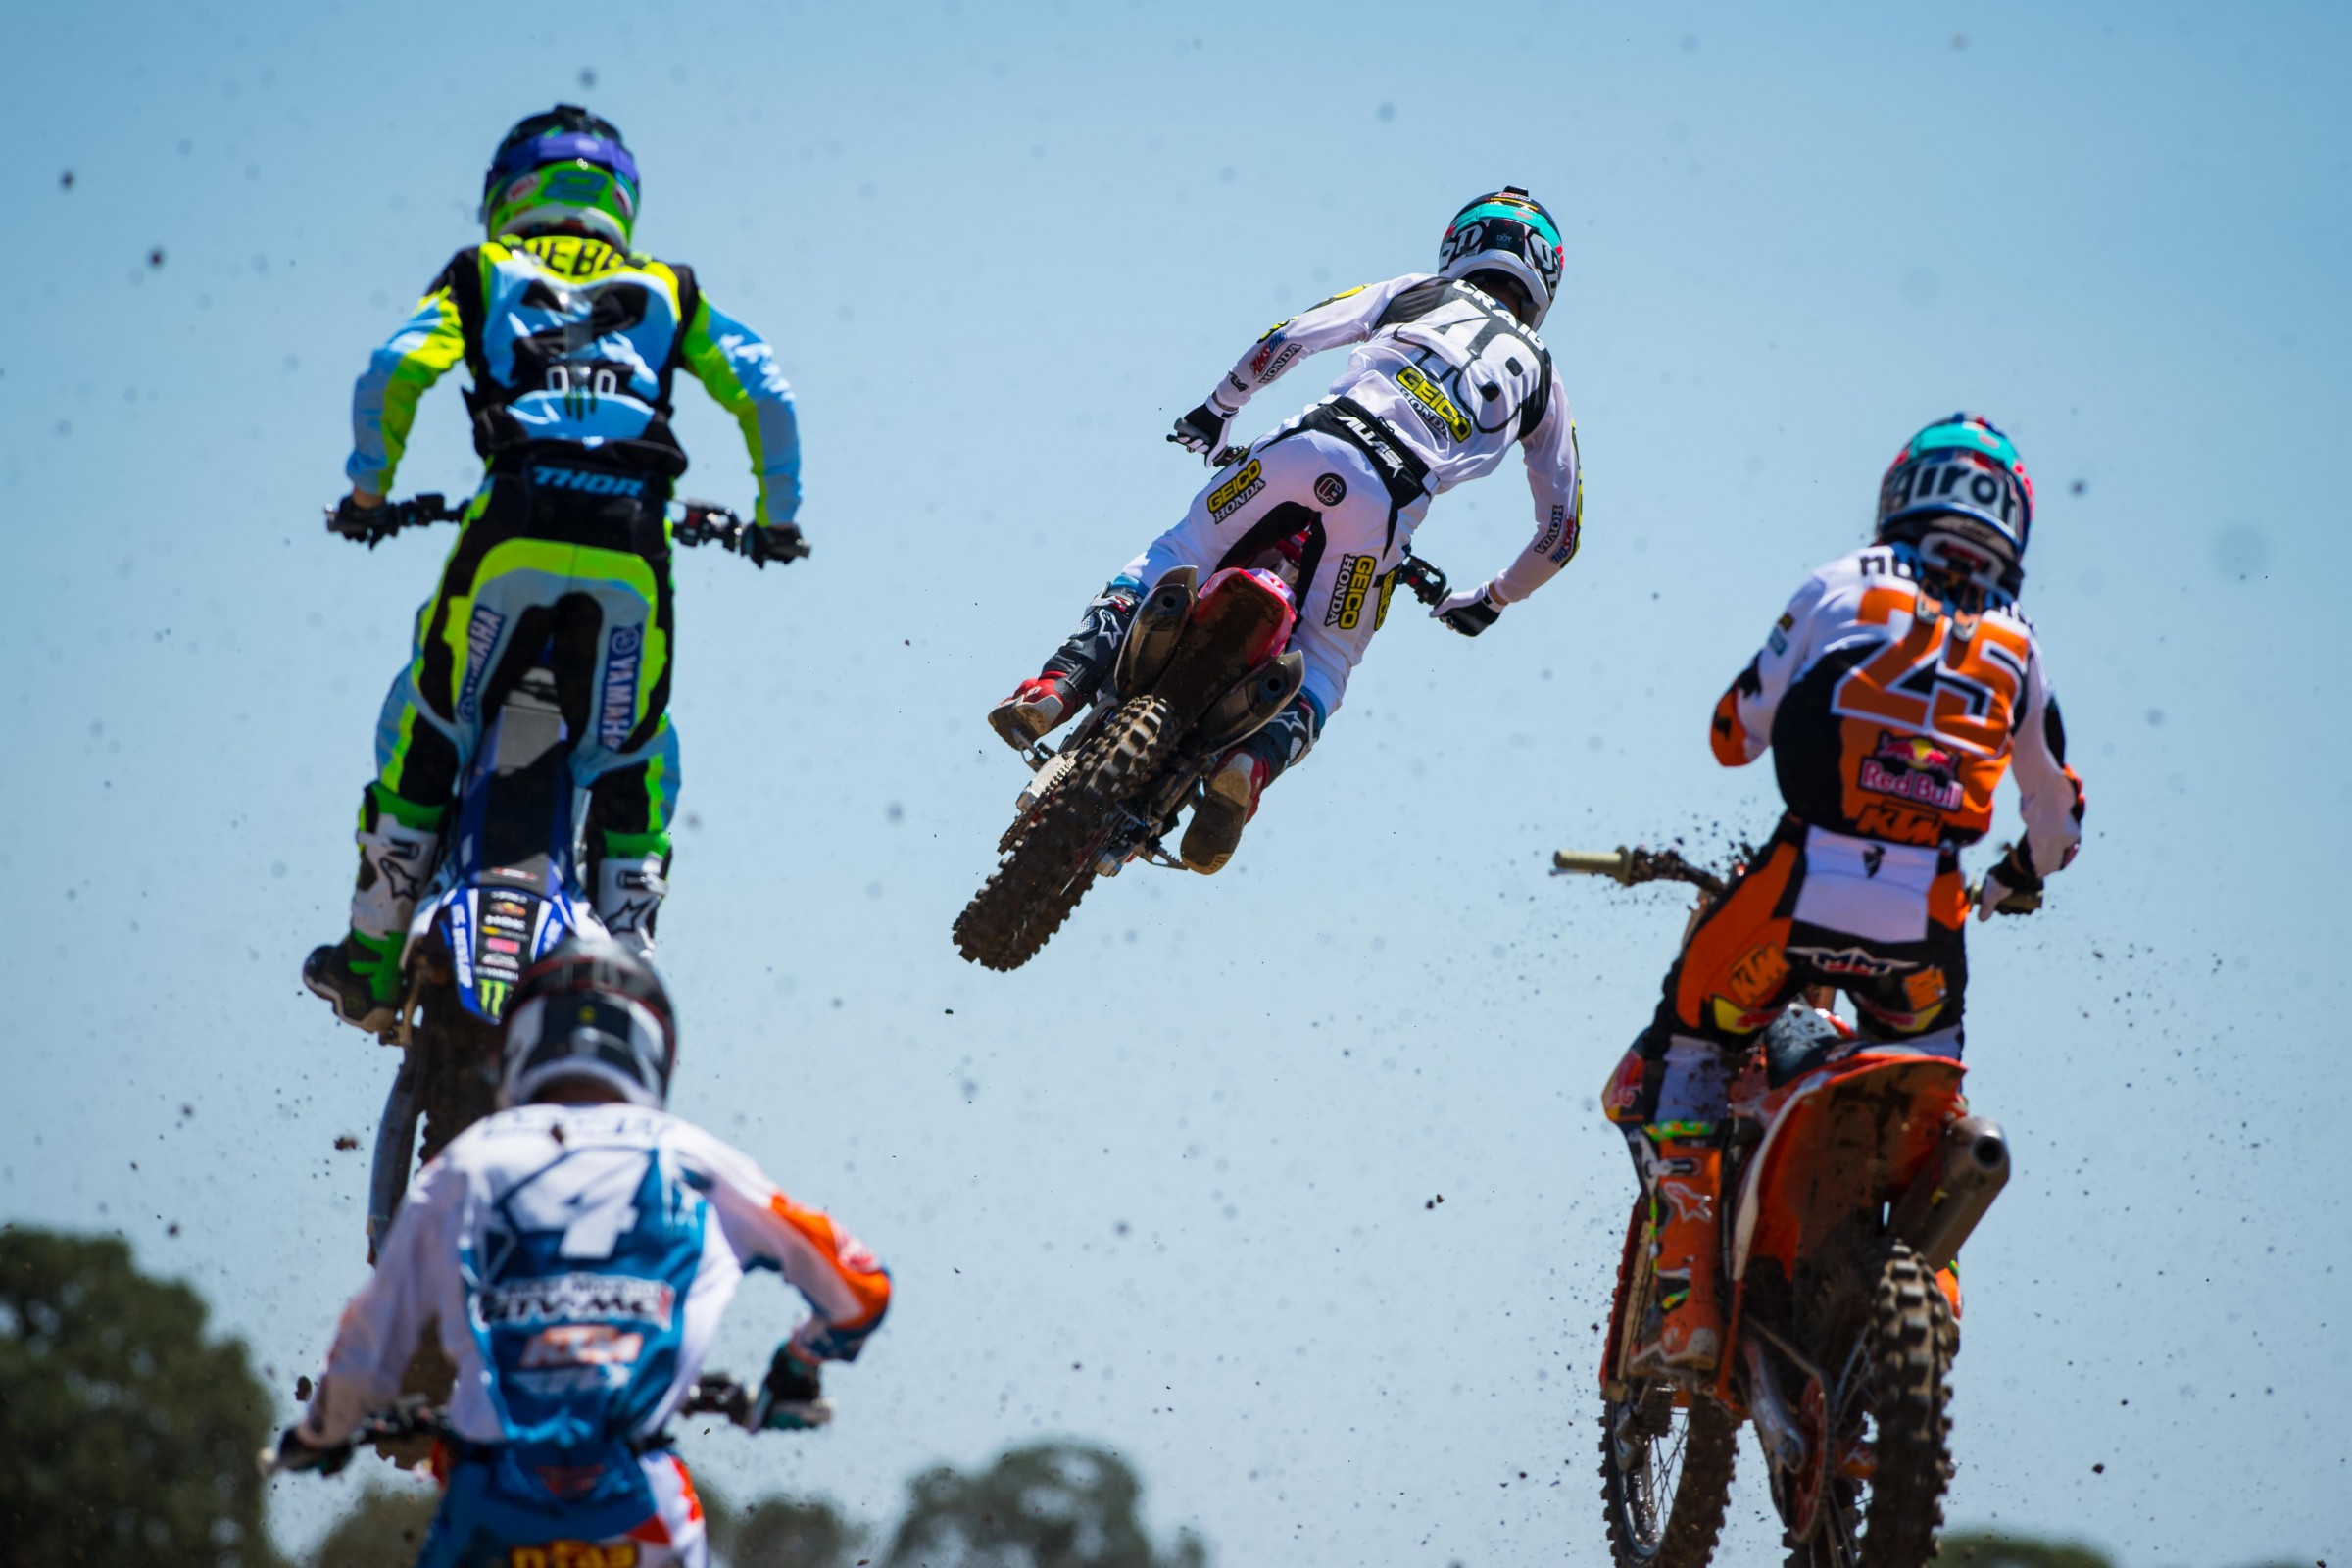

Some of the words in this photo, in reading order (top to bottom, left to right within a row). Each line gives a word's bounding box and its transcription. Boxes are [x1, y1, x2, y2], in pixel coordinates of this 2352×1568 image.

[542, 171, 608, 202] 2
[1452, 279, 1545, 351] CRAIG
[1249, 329, 1287, 378] AMSOIL
[1258, 343, 1302, 384] HONDA
[1396, 366, 1472, 443] GEICO
[1400, 388, 1448, 440] HONDA
[533, 465, 644, 496] THOR
[1207, 458, 1261, 514] GEICO
[1213, 477, 1266, 524] HONDA
[1534, 505, 1563, 554] HONDA
[1325, 554, 1357, 627] HONDA
[1339, 555, 1377, 629] GEICO
[1375, 569, 1396, 631] GEICO
[466, 609, 503, 692] MAHA
[1830, 586, 2029, 760] 25
[1863, 758, 1913, 795] Red
[1913, 772, 1963, 810] Bull
[1729, 943, 1789, 1005] KTM
[506, 1146, 655, 1259] 4
